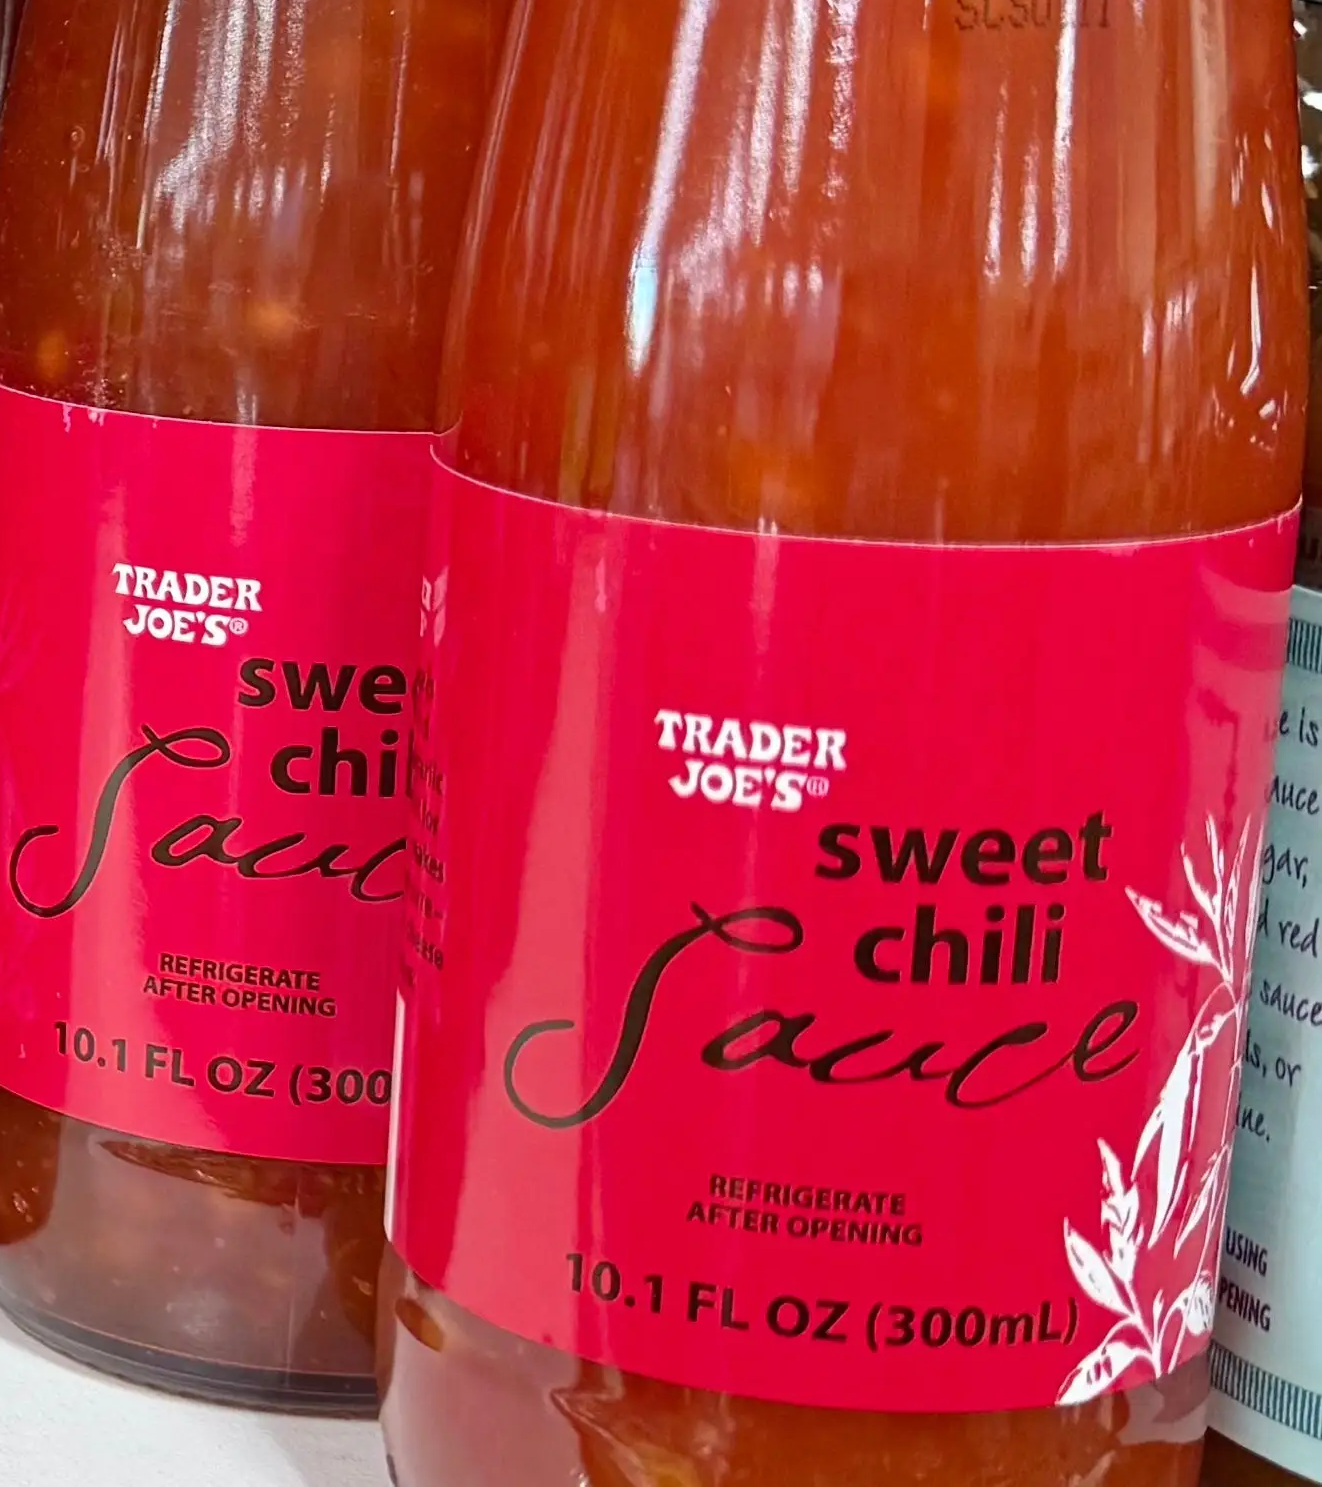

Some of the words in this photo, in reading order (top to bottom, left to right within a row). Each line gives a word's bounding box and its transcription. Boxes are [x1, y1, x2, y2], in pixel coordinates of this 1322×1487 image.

[111, 562, 263, 612] TRADER
[237, 655, 407, 715] swe
[655, 708, 848, 770] TRADER
[1299, 707, 1320, 748] is
[270, 725, 398, 798] chi
[1266, 775, 1321, 815] auce
[815, 809, 1114, 886] sweet
[853, 902, 1066, 987] chili
[1279, 918, 1320, 958] red
[159, 951, 321, 992] REFRIGERATE
[143, 977, 216, 1008] AFTER
[222, 987, 336, 1017] OPENING
[504, 901, 1141, 1129] Sauce
[1260, 980, 1322, 1026] sauce
[54, 1019, 128, 1073] 10.1
[145, 1044, 195, 1087] FL
[207, 1055, 275, 1099] OZ
[288, 1062, 392, 1106] (300
[1275, 1058, 1301, 1088] or
[709, 1173, 905, 1216] REFRIGERATE
[687, 1200, 779, 1236] AFTER
[786, 1211, 924, 1248] OPENING
[1225, 1226, 1268, 1277] USING
[565, 1252, 664, 1314] 10.1
[686, 1282, 750, 1332] FL
[766, 1296, 851, 1344] OZ
[865, 1298, 1079, 1350] (300mL)
[1218, 1277, 1271, 1332] PENING
